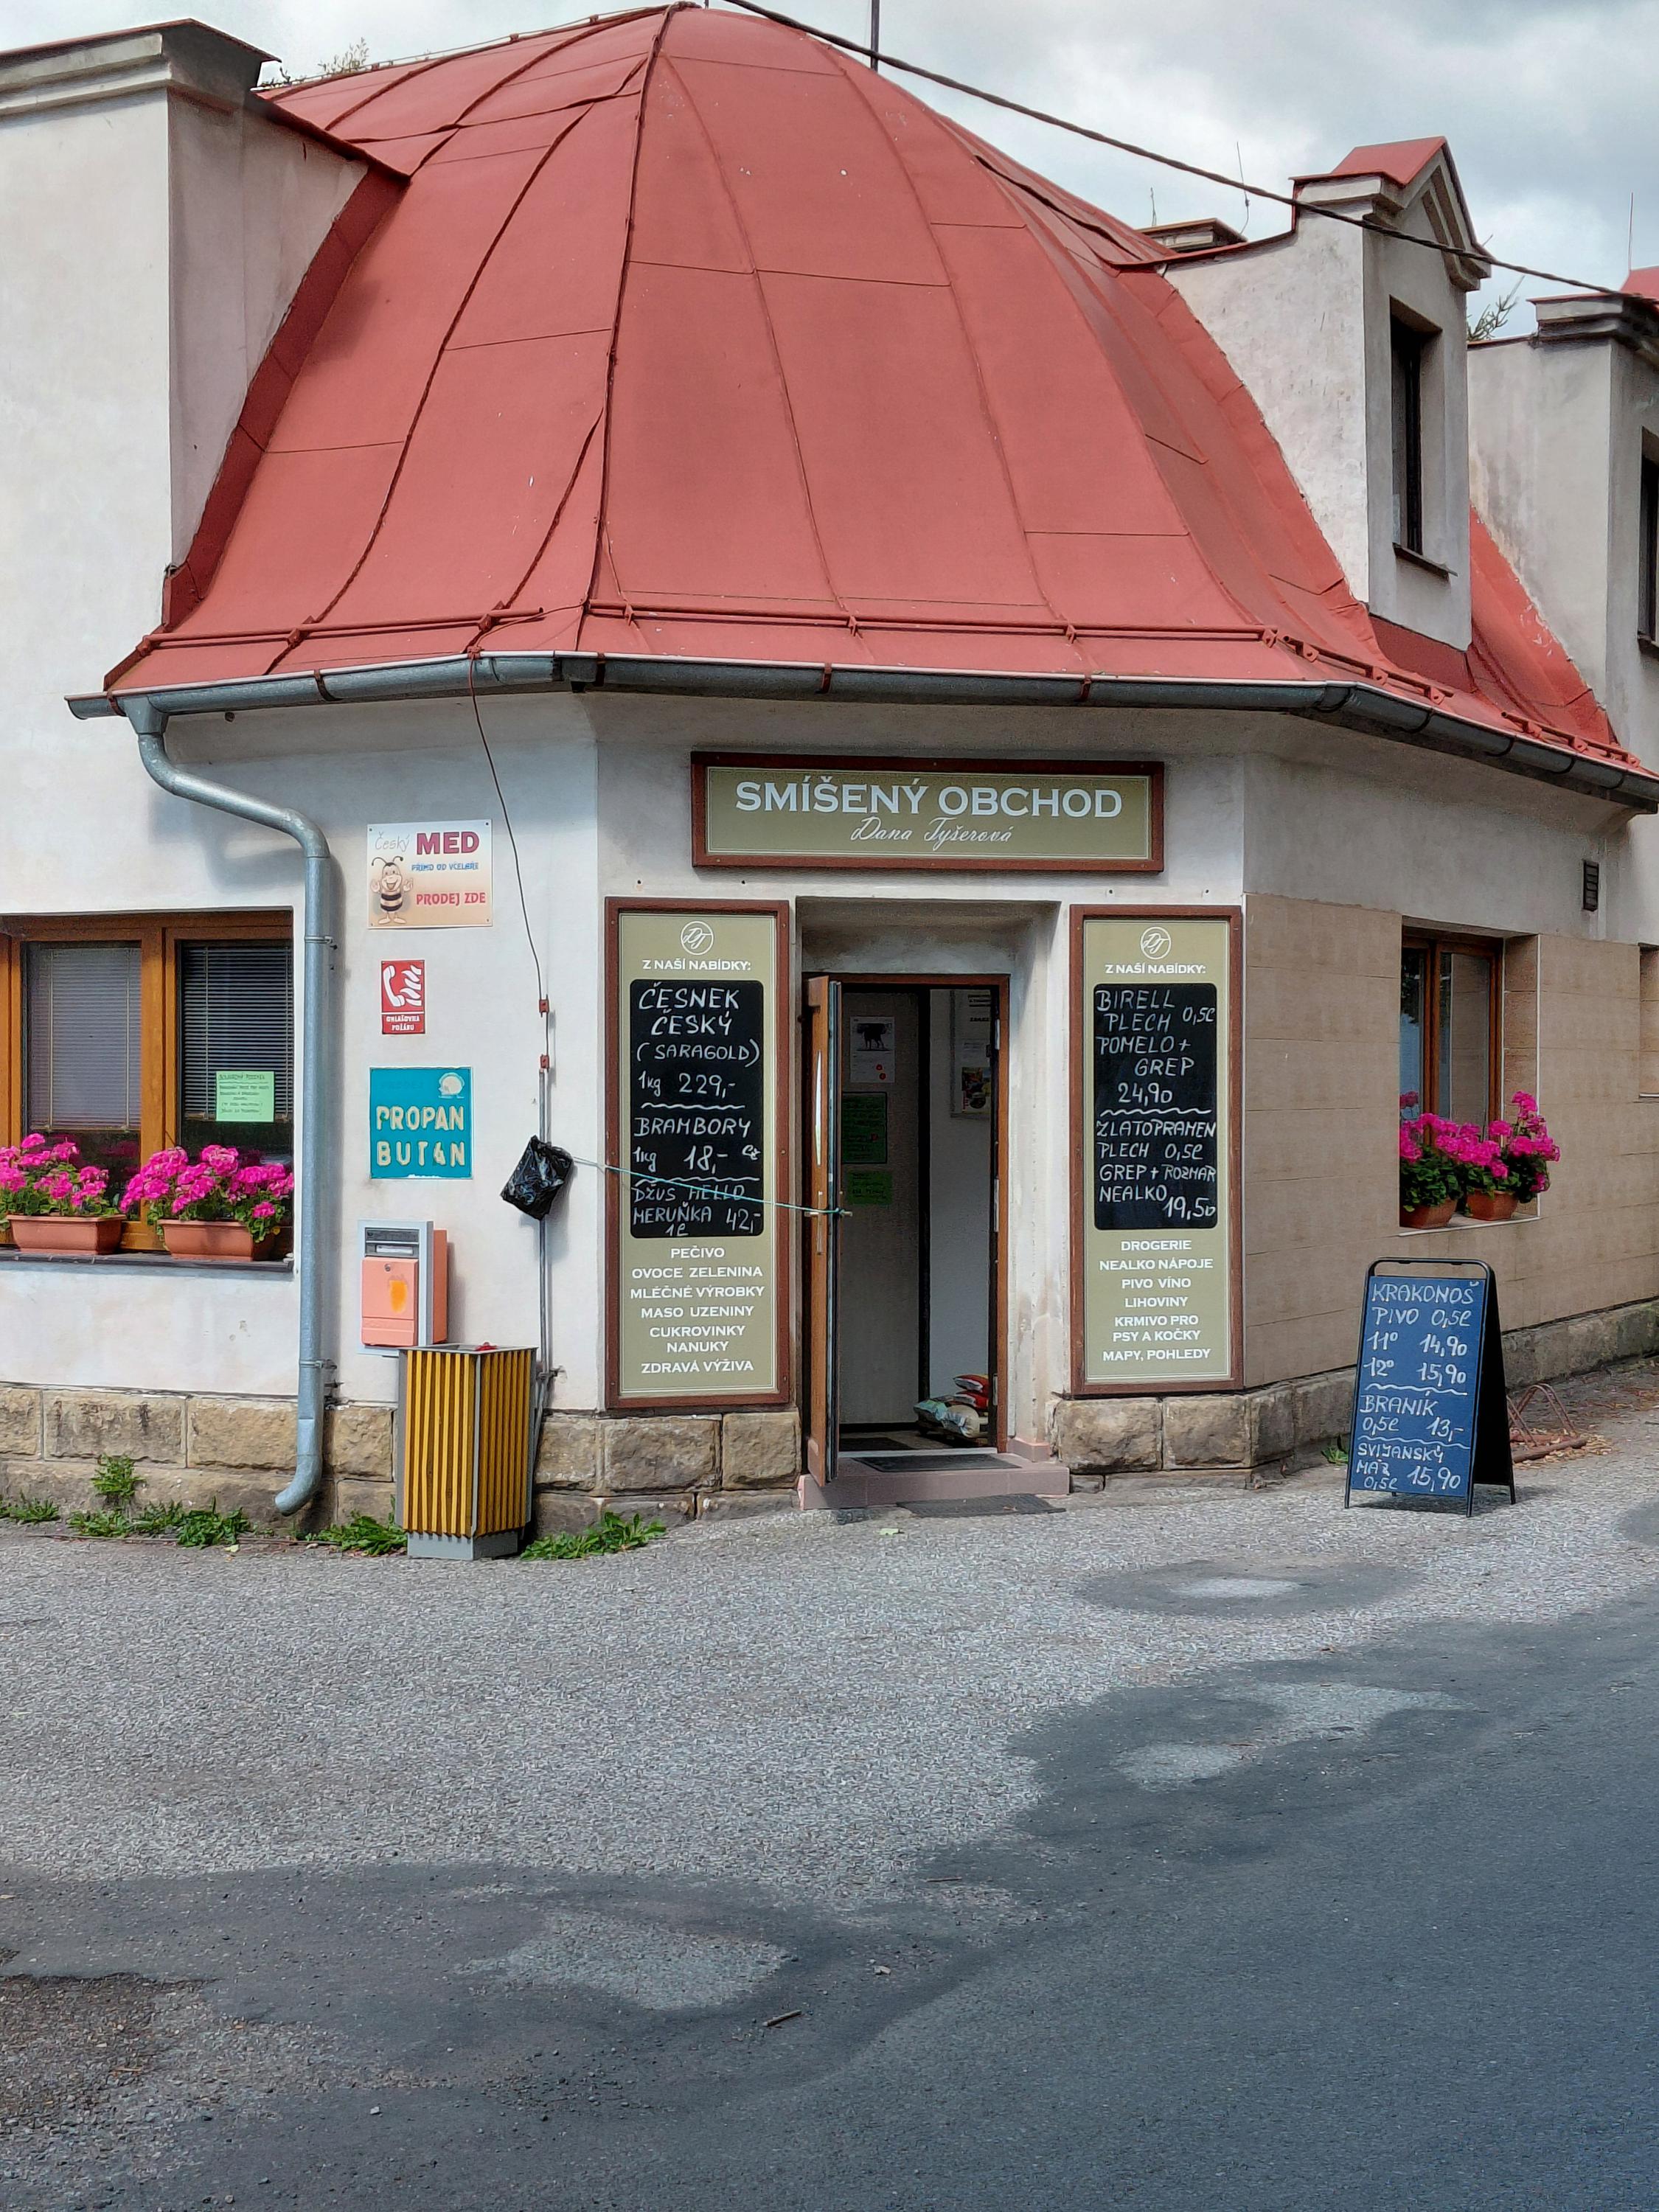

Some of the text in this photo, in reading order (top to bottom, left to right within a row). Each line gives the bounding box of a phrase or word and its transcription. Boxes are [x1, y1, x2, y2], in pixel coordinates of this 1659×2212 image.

[736, 776, 1122, 818] SMÍŠENÝ OBCHOD
[851, 815, 1013, 851] Dana Tyšerová
[375, 832, 479, 855] Český MED
[437, 863, 447, 871] OD
[416, 892, 486, 906] PRODEJ ZDE
[642, 959, 751, 970] Z NAŠÍ NABÍDKY:
[1105, 962, 1206, 974] Z NAŠÍ NABÍDKY:
[639, 981, 740, 1009] ČESNEK
[1095, 990, 1175, 1011] BIRELL
[650, 1009, 732, 1035] ČESKÝ
[1104, 1013, 1172, 1032] PLECH
[1096, 1035, 1175, 1055] POMELO
[1135, 1057, 1194, 1077] GREP
[638, 1071, 736, 1098] 1kg 229,-
[1118, 1082, 1173, 1106] 24,90
[376, 1106, 464, 1130] PROPAN
[633, 1117, 751, 1138] BRAMBORY
[1096, 1119, 1216, 1138] ZLATOPRAMEN
[1096, 1142, 1150, 1158] PLECH
[633, 1147, 657, 1173] 1kg
[684, 1145, 728, 1175] 18,-
[1099, 1164, 1147, 1181] GREP
[1161, 1164, 1216, 1182] ROZMAR
[631, 1183, 745, 1203] DŽUS HELLO
[1099, 1185, 1167, 1203] NEALKO
[633, 1201, 761, 1234] MERUŇKA 42,-
[1163, 1196, 1215, 1220] 19,50
[670, 1245, 725, 1259] PEČIVO
[1121, 1239, 1192, 1251] DROGERIE
[632, 1266, 763, 1279] OVOCE ZELENINA
[1099, 1257, 1213, 1270] NEALKO NÁPOJE
[630, 1284, 765, 1299] MLÉČNÉ VÝROBKY
[1121, 1276, 1192, 1289] PIVO VÍNO
[1124, 1297, 1189, 1307] LIHOVINY
[1371, 1281, 1479, 1304] KRAKONOŠ
[641, 1306, 754, 1318] MASO UZENINY
[1114, 1315, 1199, 1327] KRMIVO PRO
[1371, 1307, 1419, 1326] PIVO
[650, 1325, 745, 1338] CUKROVINKY
[1113, 1329, 1200, 1342] PSY A KOČKY
[667, 1341, 729, 1353] NANUKY
[1419, 1333, 1467, 1357] 14,90
[1103, 1349, 1211, 1361] MAPY, POHLEDY
[641, 1358, 754, 1374] ZDRAVÁ VÝŽIVA
[1416, 1363, 1466, 1387] 15,90
[1360, 1391, 1439, 1416] BRANÍK
[1426, 1417, 1464, 1442] 13,-
[1357, 1442, 1444, 1463] SVIJANSKÝ
[1407, 1465, 1461, 1492] 15,90
